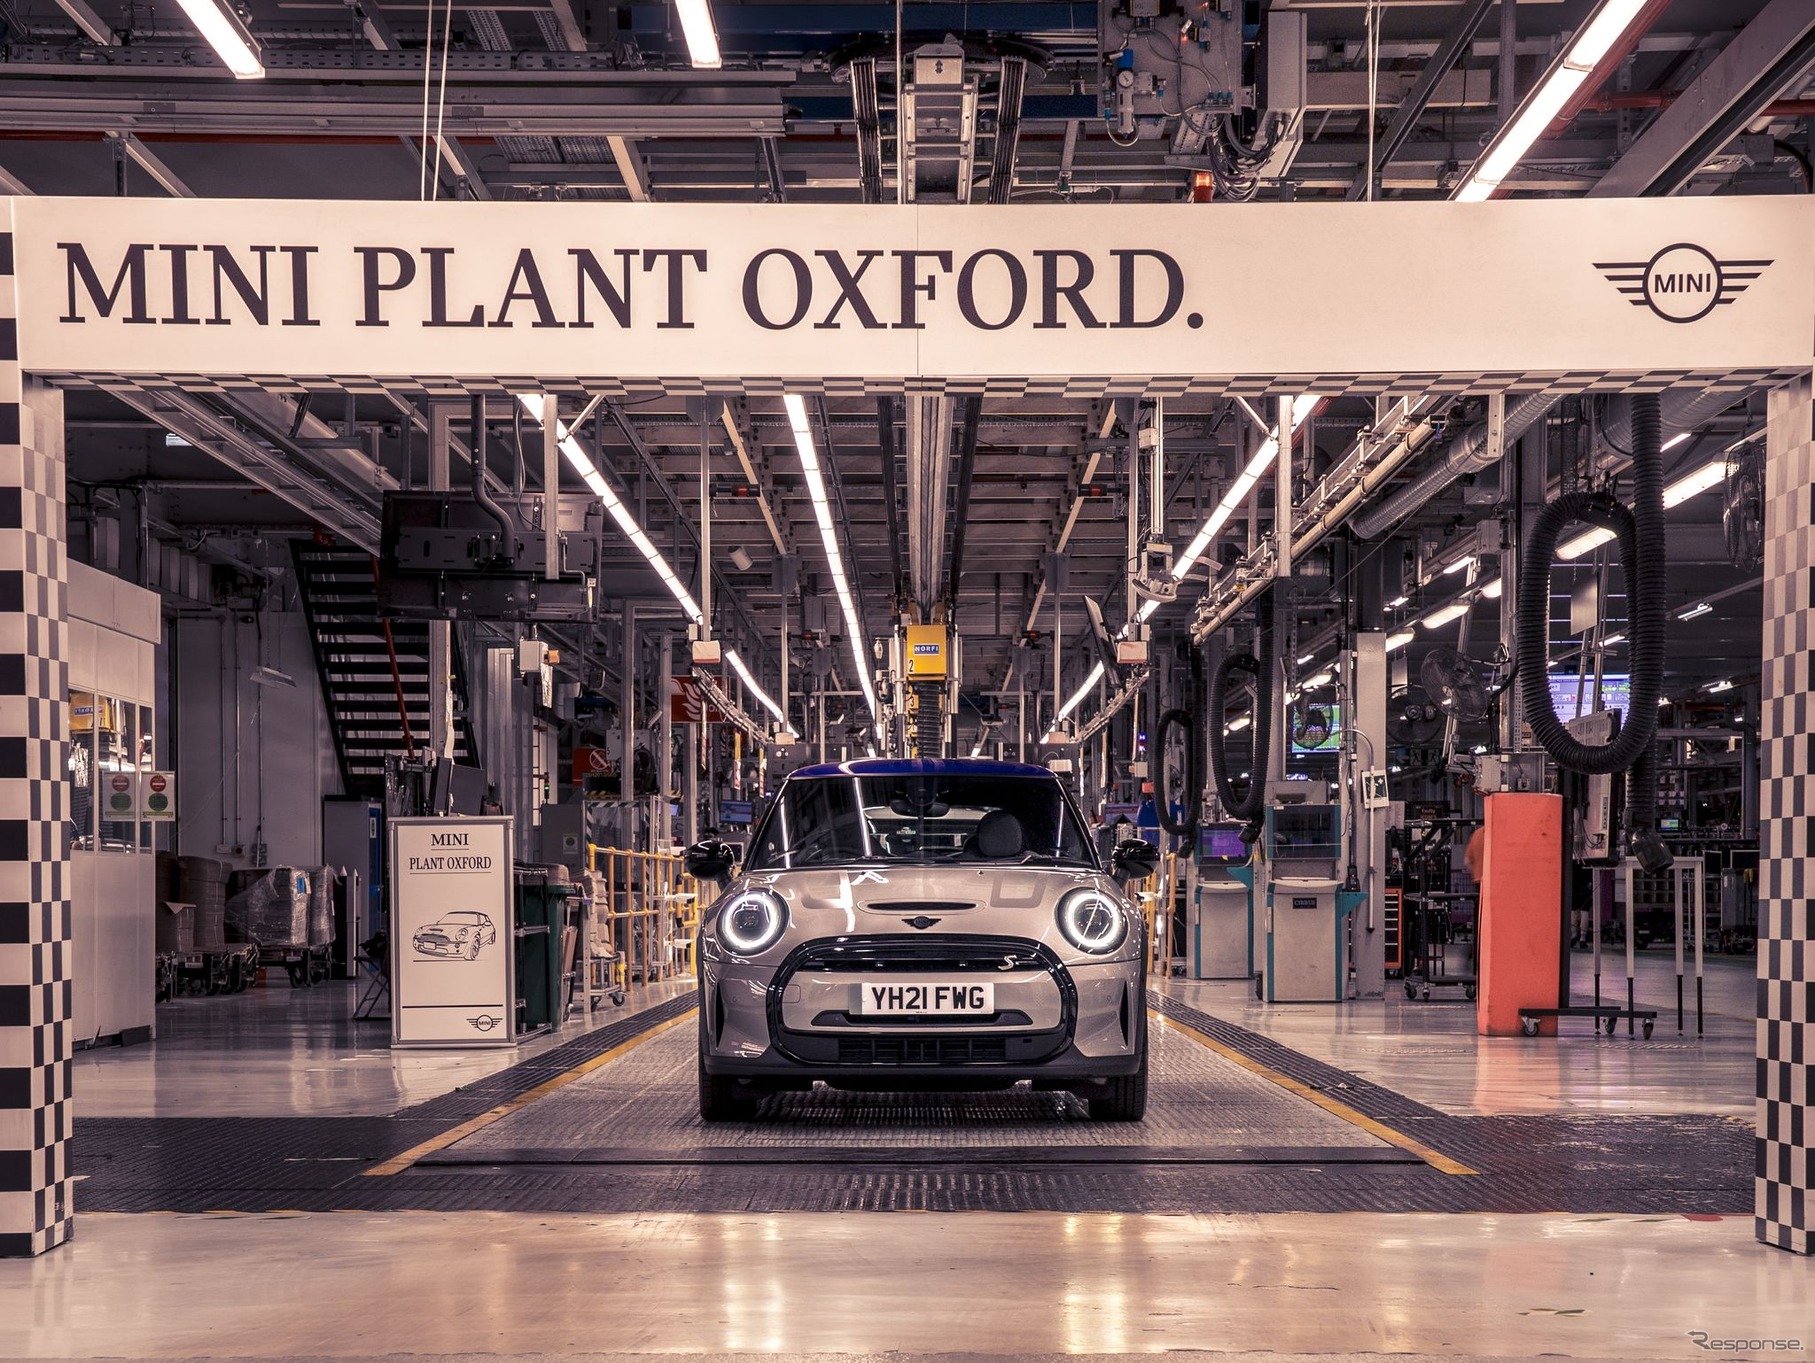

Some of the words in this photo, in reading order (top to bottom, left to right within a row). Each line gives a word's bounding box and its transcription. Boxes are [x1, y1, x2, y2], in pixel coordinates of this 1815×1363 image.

[57, 243, 320, 326] MINI
[354, 246, 707, 328] PLANT
[743, 248, 1204, 330] OXFORD.
[1654, 273, 1711, 294] MINI
[914, 645, 939, 653] NORFI
[908, 659, 914, 673] 2
[431, 833, 470, 846] MINI
[409, 857, 445, 870] PLANT
[446, 856, 492, 869] OXFORD
[997, 954, 1017, 971] S
[872, 986, 927, 1010] YH21
[935, 986, 984, 1010] FWG
